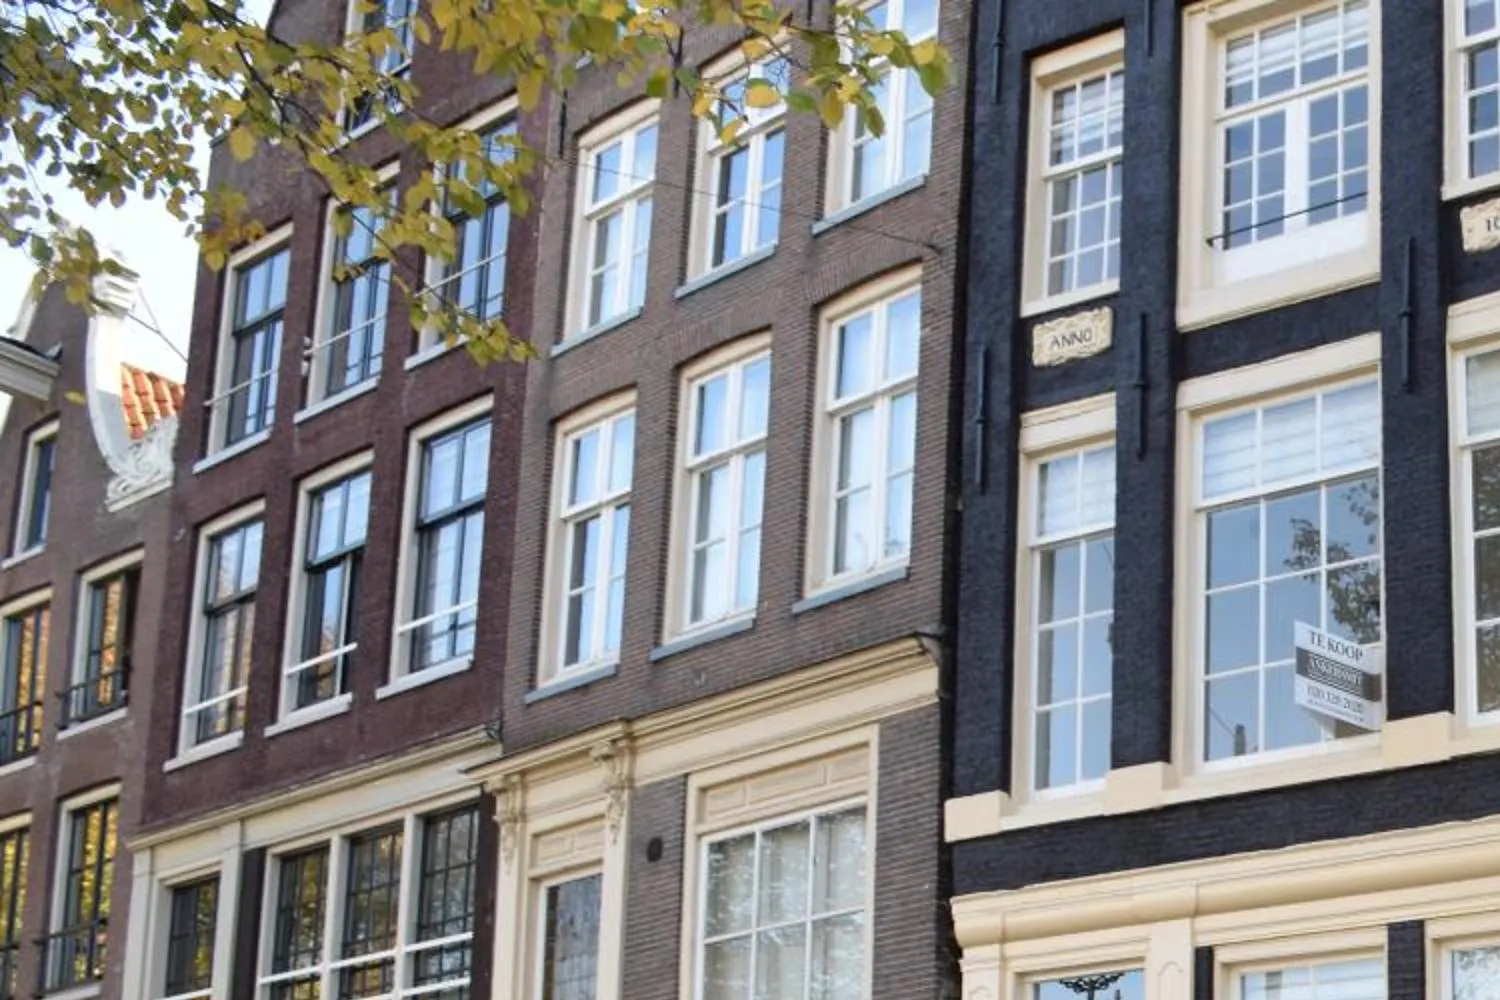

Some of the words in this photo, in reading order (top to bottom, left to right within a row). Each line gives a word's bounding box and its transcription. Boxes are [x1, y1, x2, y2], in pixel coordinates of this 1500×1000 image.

[1049, 328, 1093, 350] ANNO
[1310, 630, 1326, 649] TE
[1327, 638, 1363, 661] KOOP
